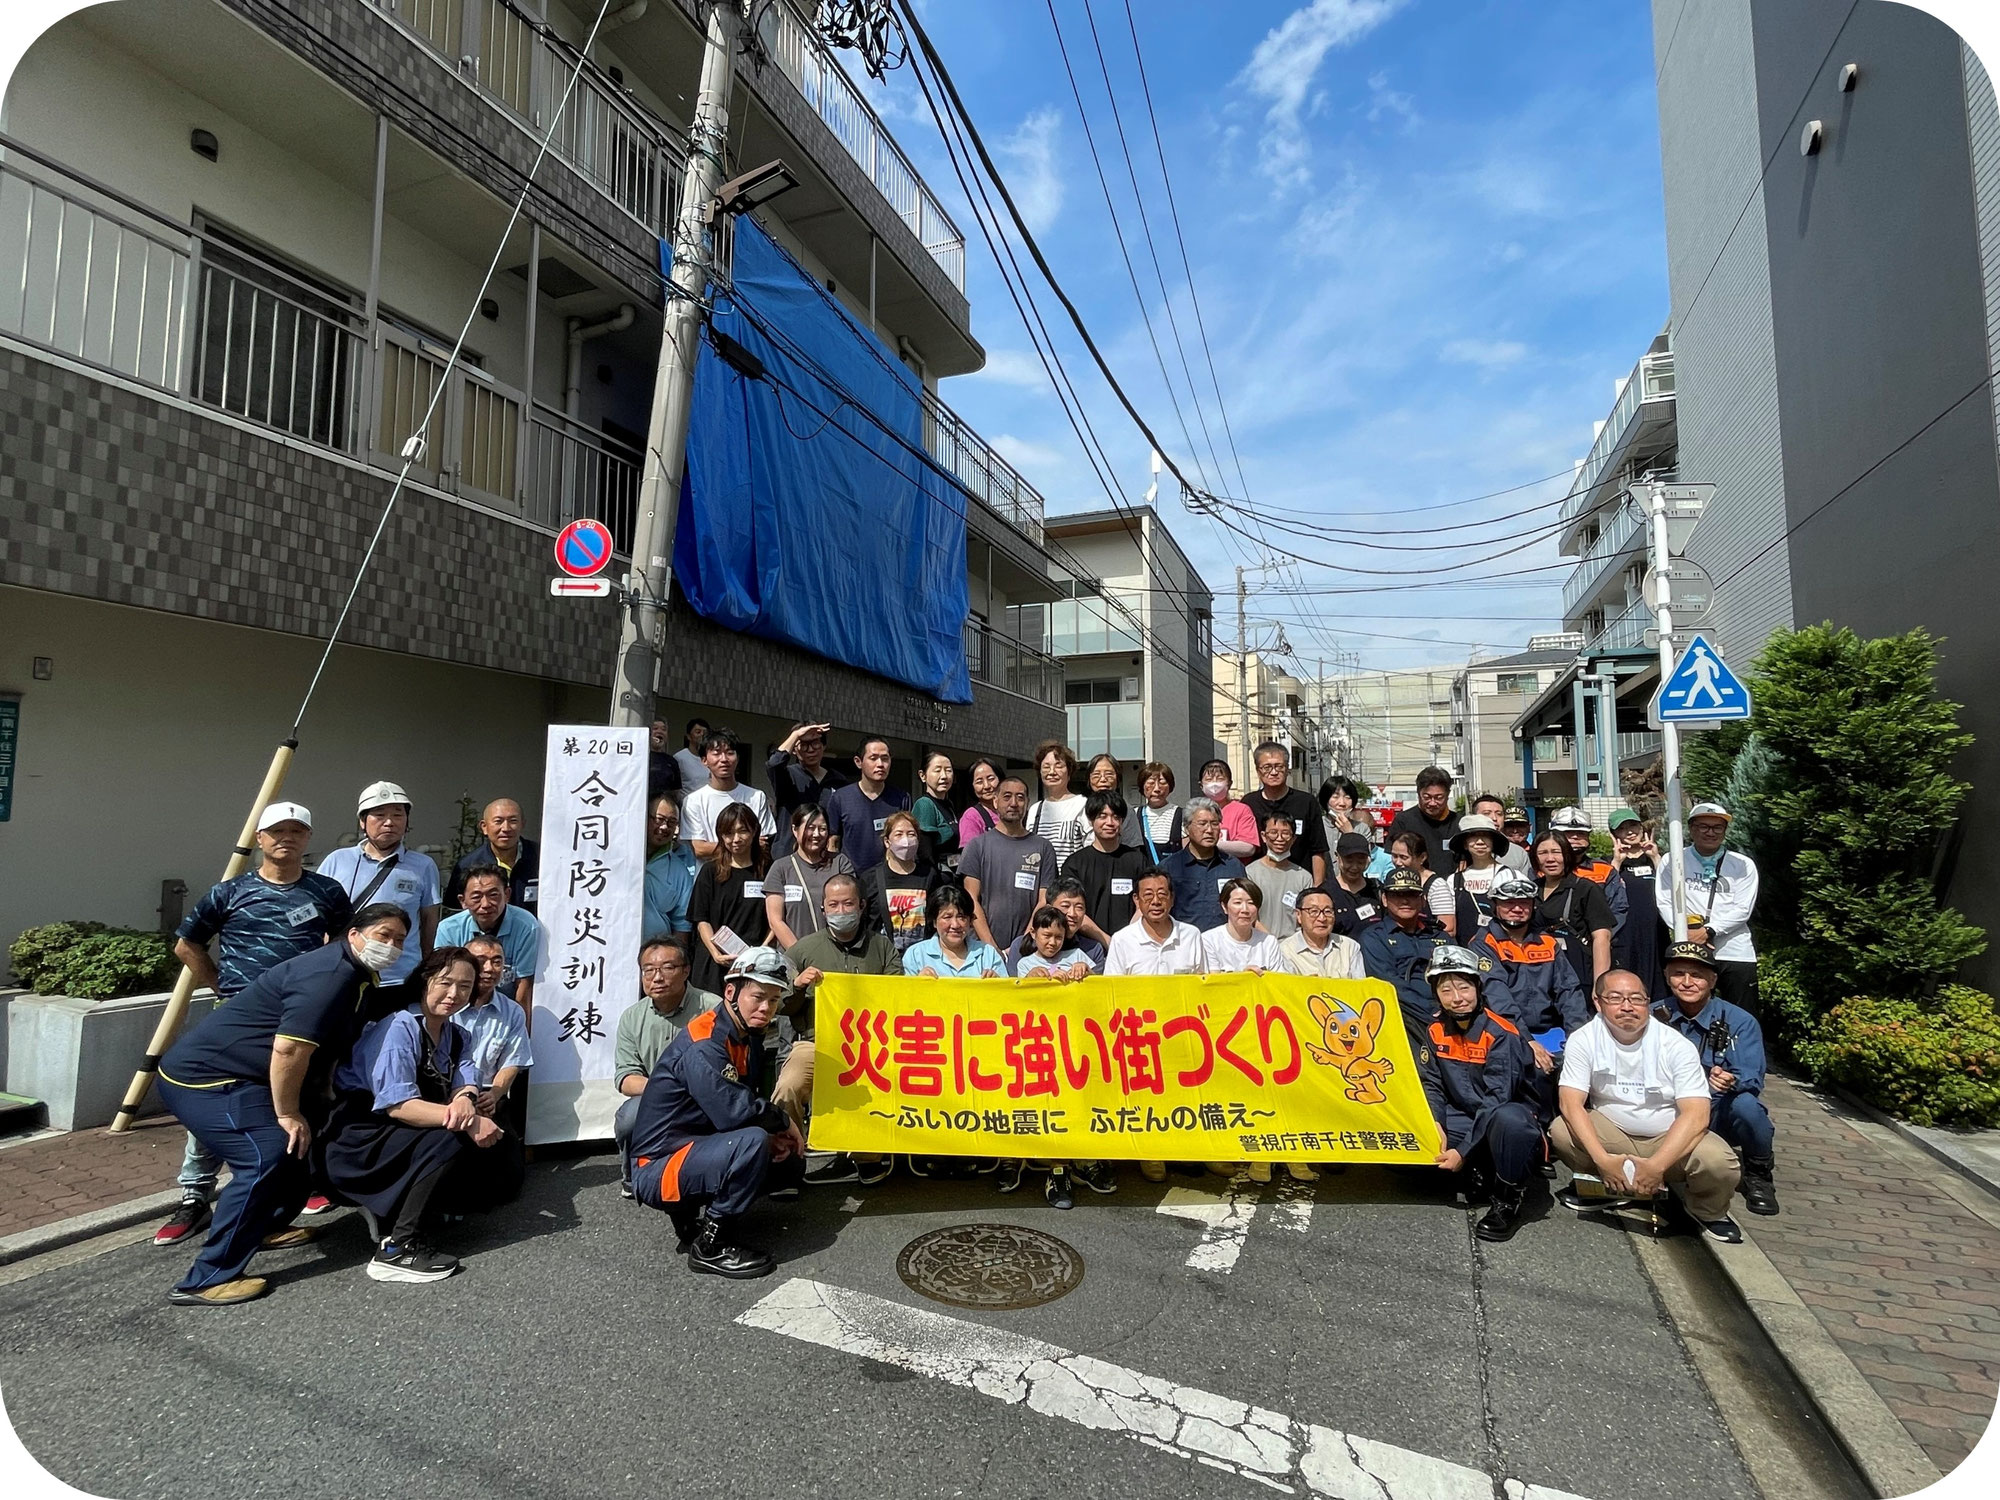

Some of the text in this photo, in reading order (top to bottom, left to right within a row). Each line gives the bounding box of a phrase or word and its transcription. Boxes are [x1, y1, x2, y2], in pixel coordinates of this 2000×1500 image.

[576, 521, 596, 529] 8-20
[562, 736, 634, 757] 第20回
[1505, 806, 1526, 815] OKYO
[1391, 870, 1420, 881] TOKYO
[556, 769, 619, 1046] 合同防災訓練
[889, 895, 917, 908] NIKE
[1671, 943, 1708, 958] TOKYO
[838, 1003, 1302, 1098] 災害に強い街づくり
[1239, 1130, 1421, 1153] 警視庁南千住警察署
